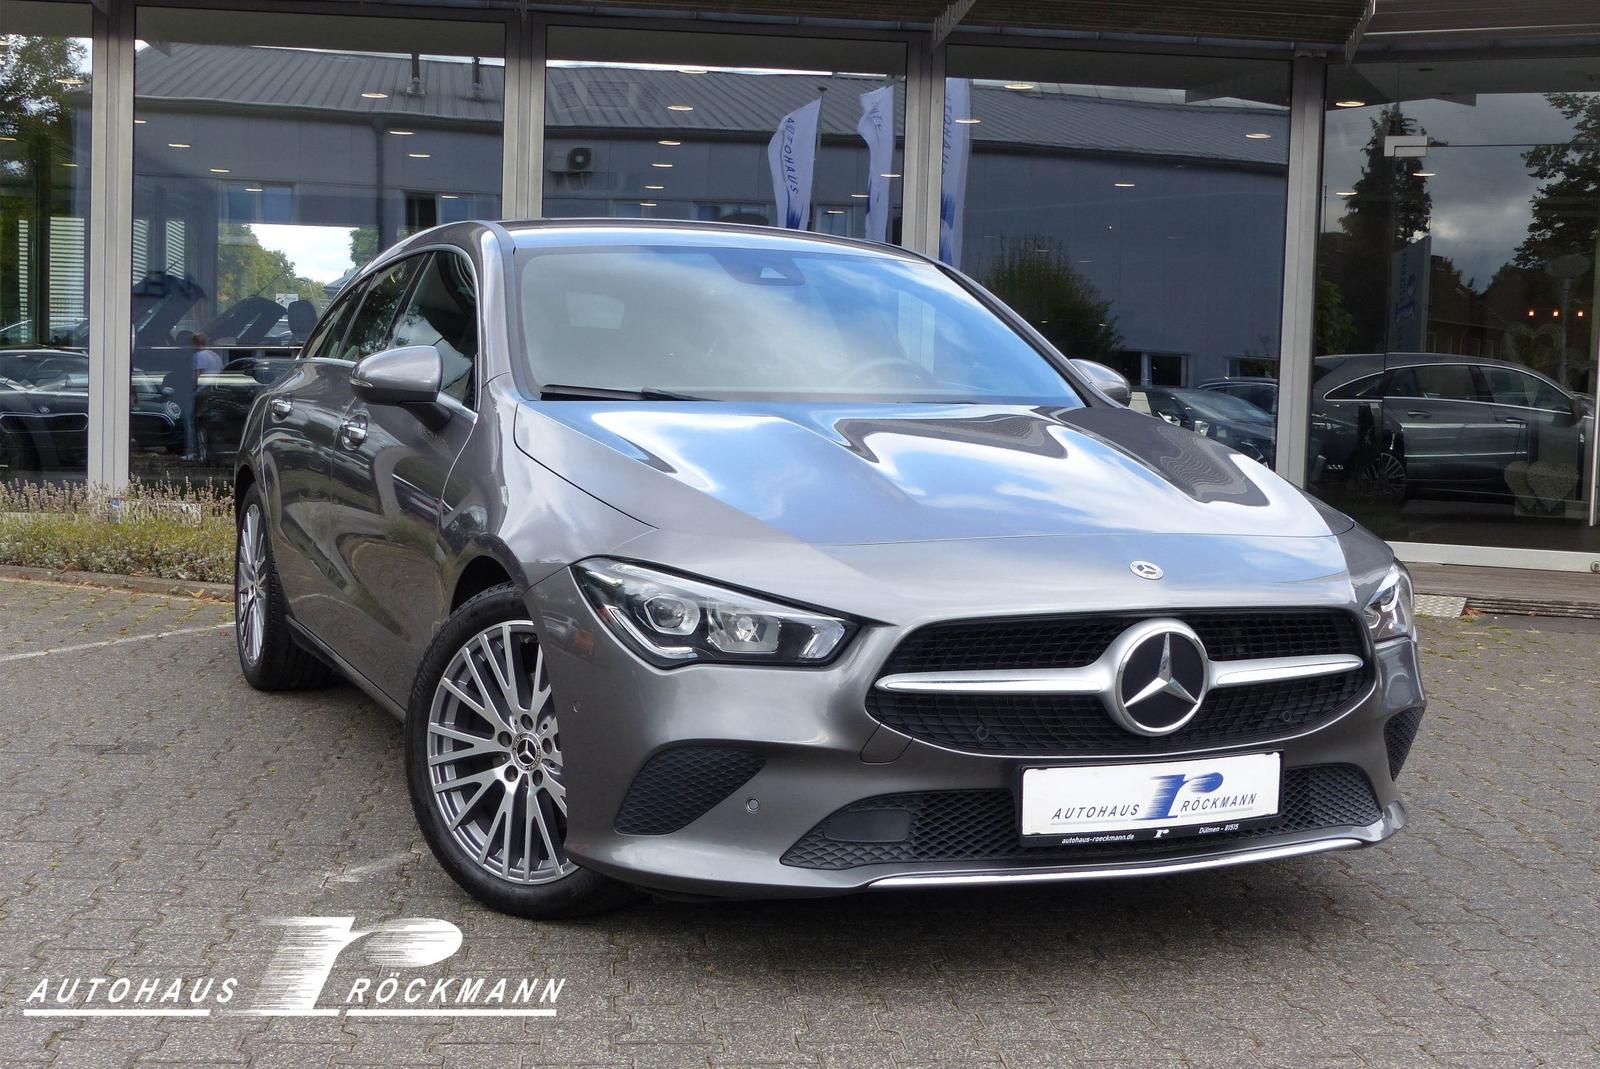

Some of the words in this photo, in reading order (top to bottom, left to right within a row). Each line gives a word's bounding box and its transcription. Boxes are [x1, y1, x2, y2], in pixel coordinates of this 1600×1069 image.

[783, 117, 800, 195] AUTOHAUS
[1051, 804, 1140, 820] AUTOHAUS
[1180, 793, 1257, 812] RÖCKMANN
[1061, 833, 1135, 844] autohaus-roeckmann.de
[1198, 826, 1220, 834] Dülmen
